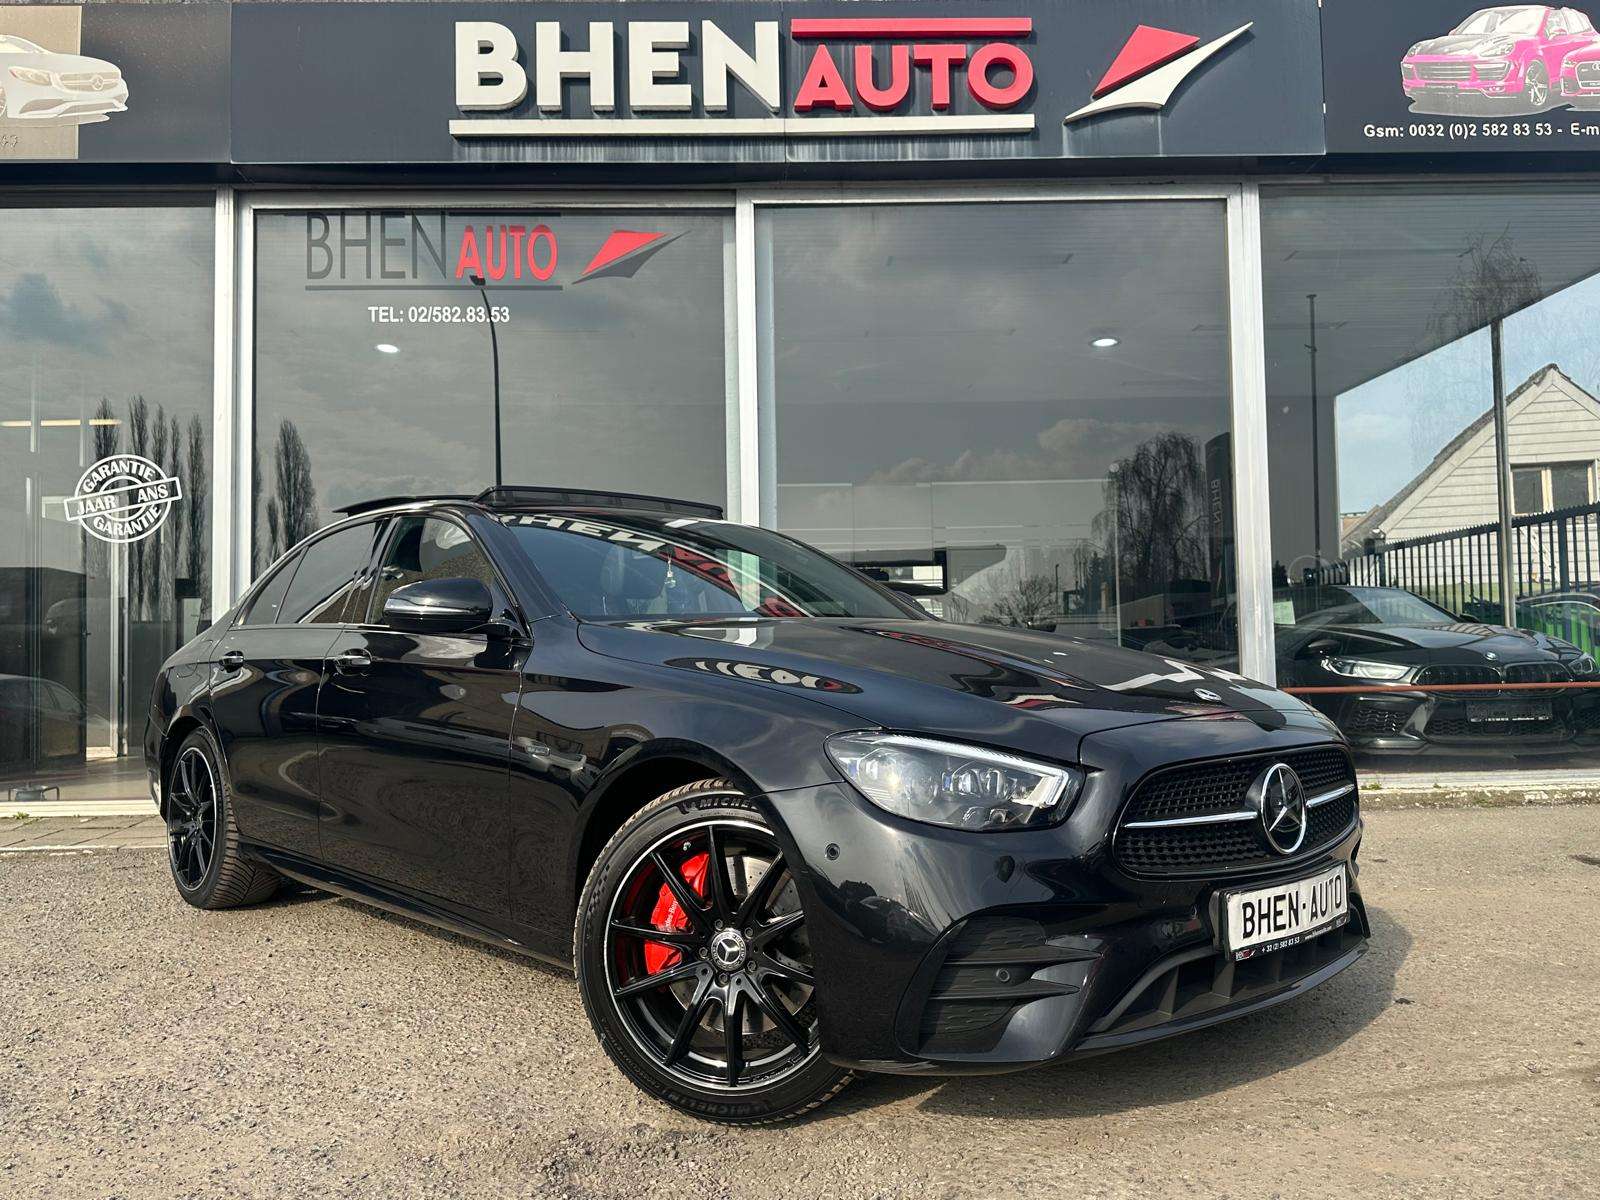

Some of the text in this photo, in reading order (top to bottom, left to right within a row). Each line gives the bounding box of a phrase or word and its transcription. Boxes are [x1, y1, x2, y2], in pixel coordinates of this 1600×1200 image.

[455, 20, 1034, 112] BHEN AUTO
[1363, 123, 1404, 138] Gsm:
[1408, 123, 1444, 137] 0032
[1449, 123, 1477, 140] (0)2
[1482, 122, 1508, 137] 582
[1512, 122, 1530, 136] 83
[1535, 122, 1552, 136] 53
[306, 210, 559, 281] BHEN AUTO
[367, 306, 510, 323] TEL: 02/582.83.53
[83, 460, 156, 493] GARANTIE
[77, 484, 169, 515] JAAR ANS
[93, 504, 162, 536] GARANTIE
